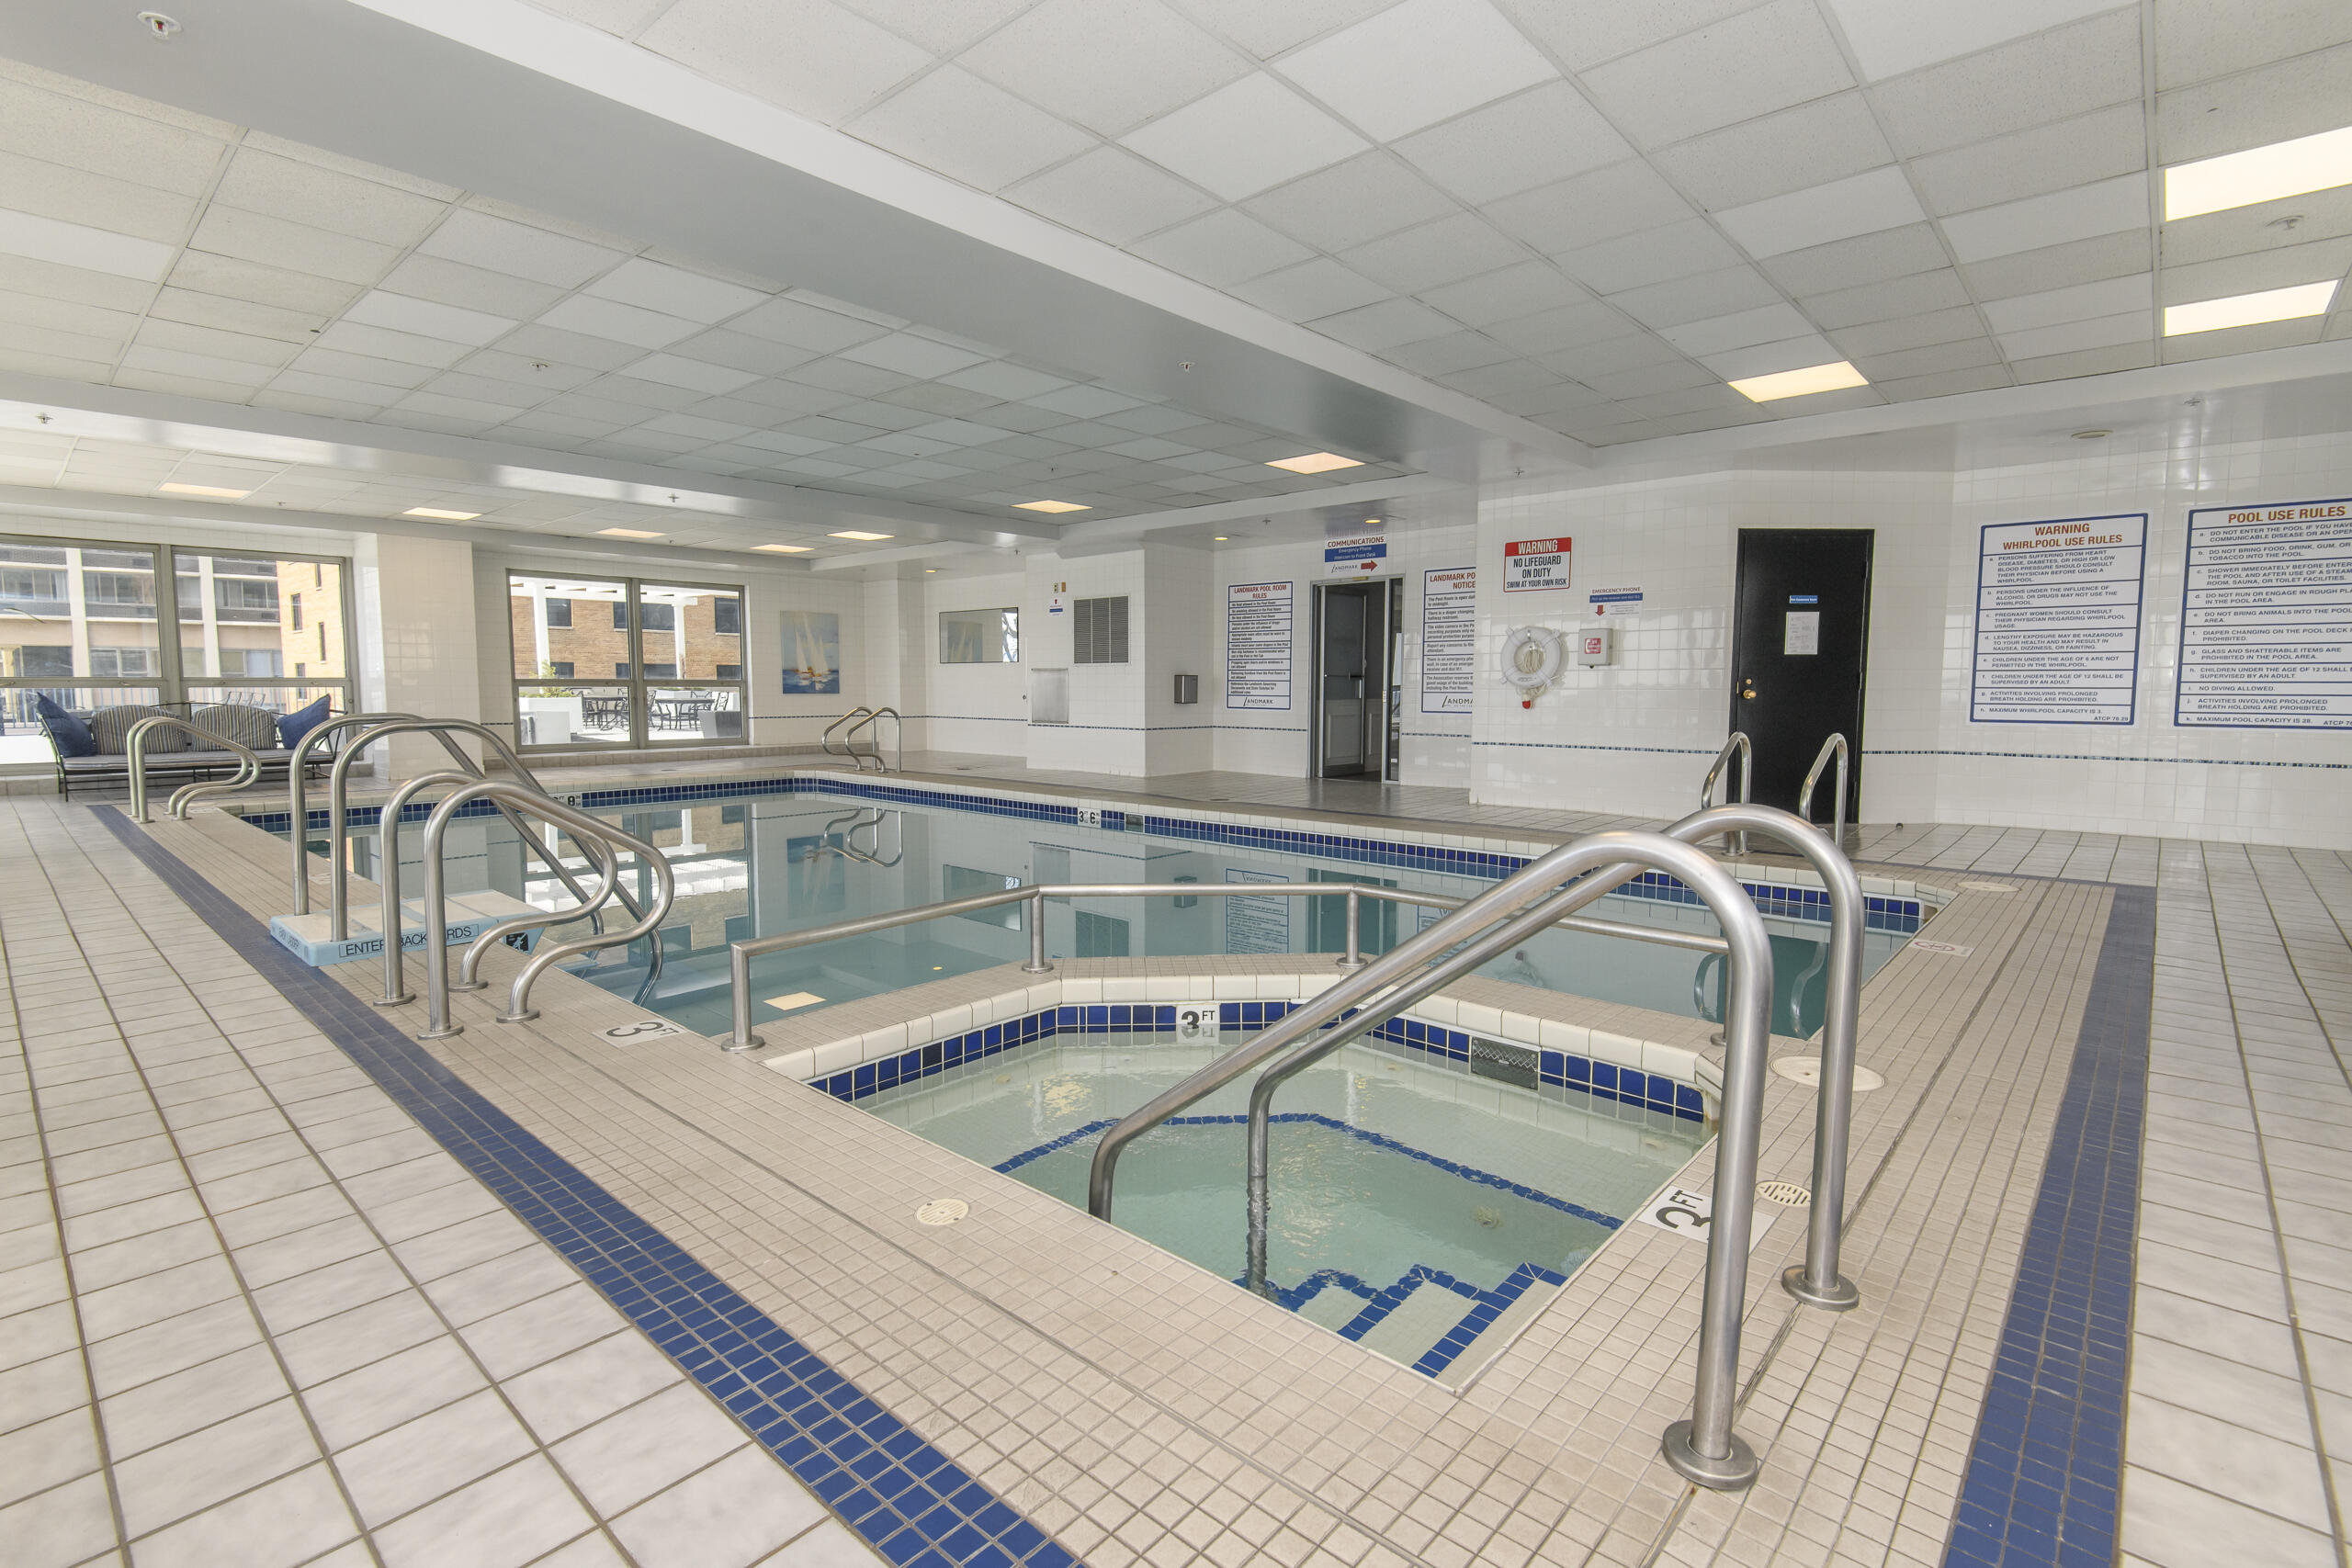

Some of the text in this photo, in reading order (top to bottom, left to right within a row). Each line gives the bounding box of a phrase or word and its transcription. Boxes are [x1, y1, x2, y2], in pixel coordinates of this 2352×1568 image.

[2228, 505, 2345, 523] POOL USE RULES
[2034, 523, 2090, 535] WARNING
[1328, 536, 1384, 548] COMMUNICATIONS
[1518, 540, 1558, 554] WARNING
[2002, 534, 2122, 549] WHIRLPOOL USE RULES
[1514, 555, 1561, 567] NO LIFEGUARD
[1430, 574, 1465, 582] LANDMARK
[1522, 567, 1551, 578] ON DUTY
[1202, 1010, 1215, 1021] FT
[606, 1022, 679, 1037] 3 FT
[1669, 1190, 1703, 1208] FT
